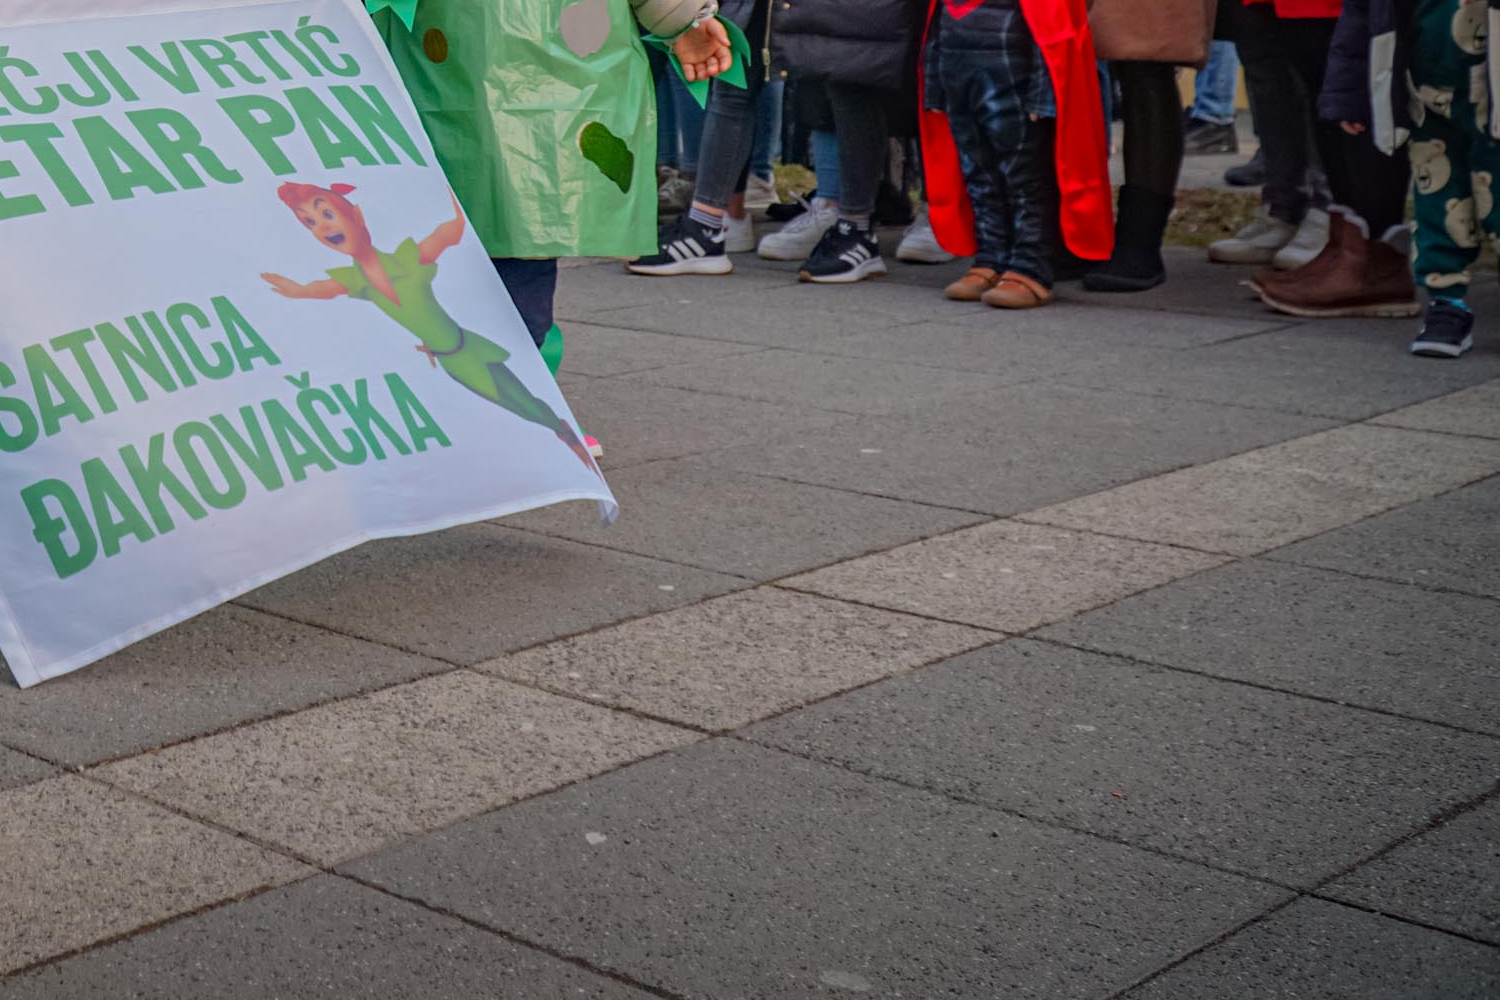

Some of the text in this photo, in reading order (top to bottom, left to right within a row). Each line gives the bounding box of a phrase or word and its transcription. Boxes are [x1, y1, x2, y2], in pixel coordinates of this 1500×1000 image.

[129, 15, 361, 93] VRTIĆ
[218, 84, 427, 175] PAN
[20, 372, 451, 579] ĐAKOVAČKA
